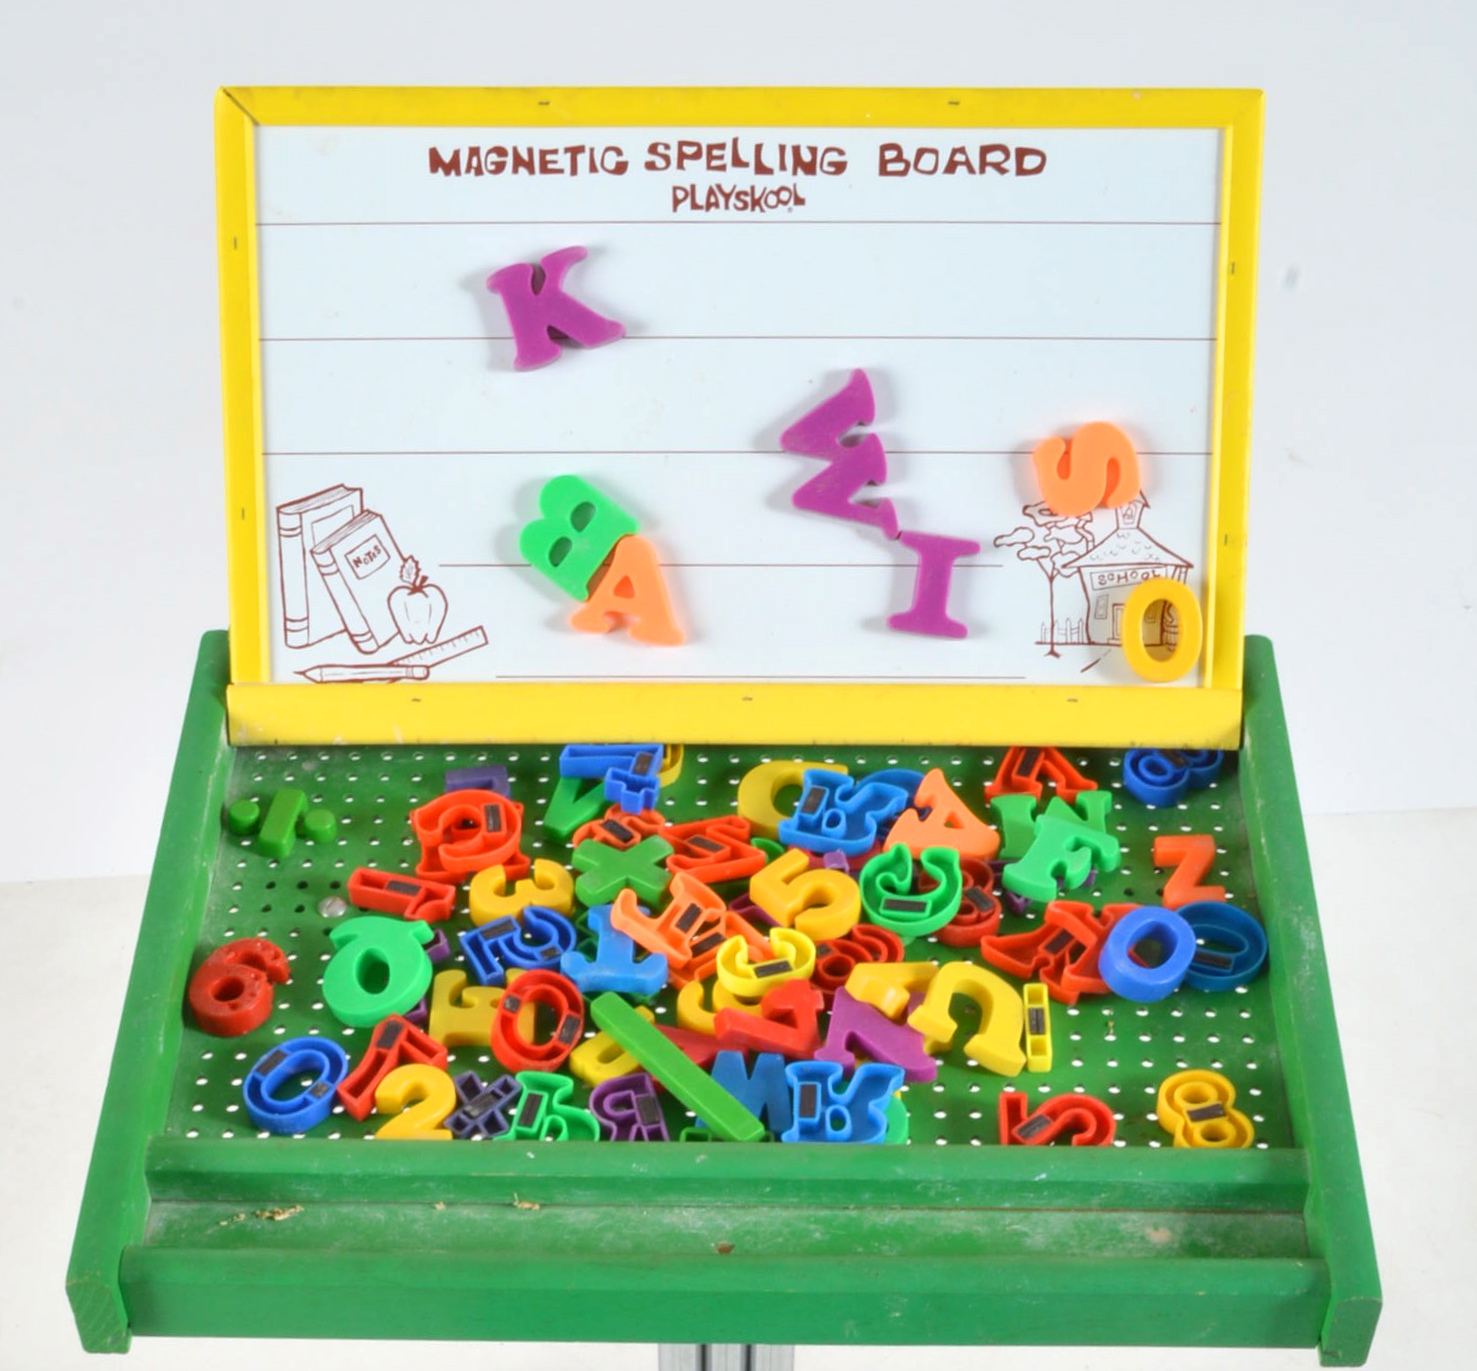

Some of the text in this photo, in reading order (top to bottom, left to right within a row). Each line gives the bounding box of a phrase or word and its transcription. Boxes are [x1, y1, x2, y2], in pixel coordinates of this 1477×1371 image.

[428, 136, 1047, 177] MAGNETIC SPELLING BOARD
[672, 183, 806, 213] PLAYSKOOL
[487, 245, 626, 372] K
[518, 474, 642, 601] B
[1097, 568, 1161, 586] SCHOOL
